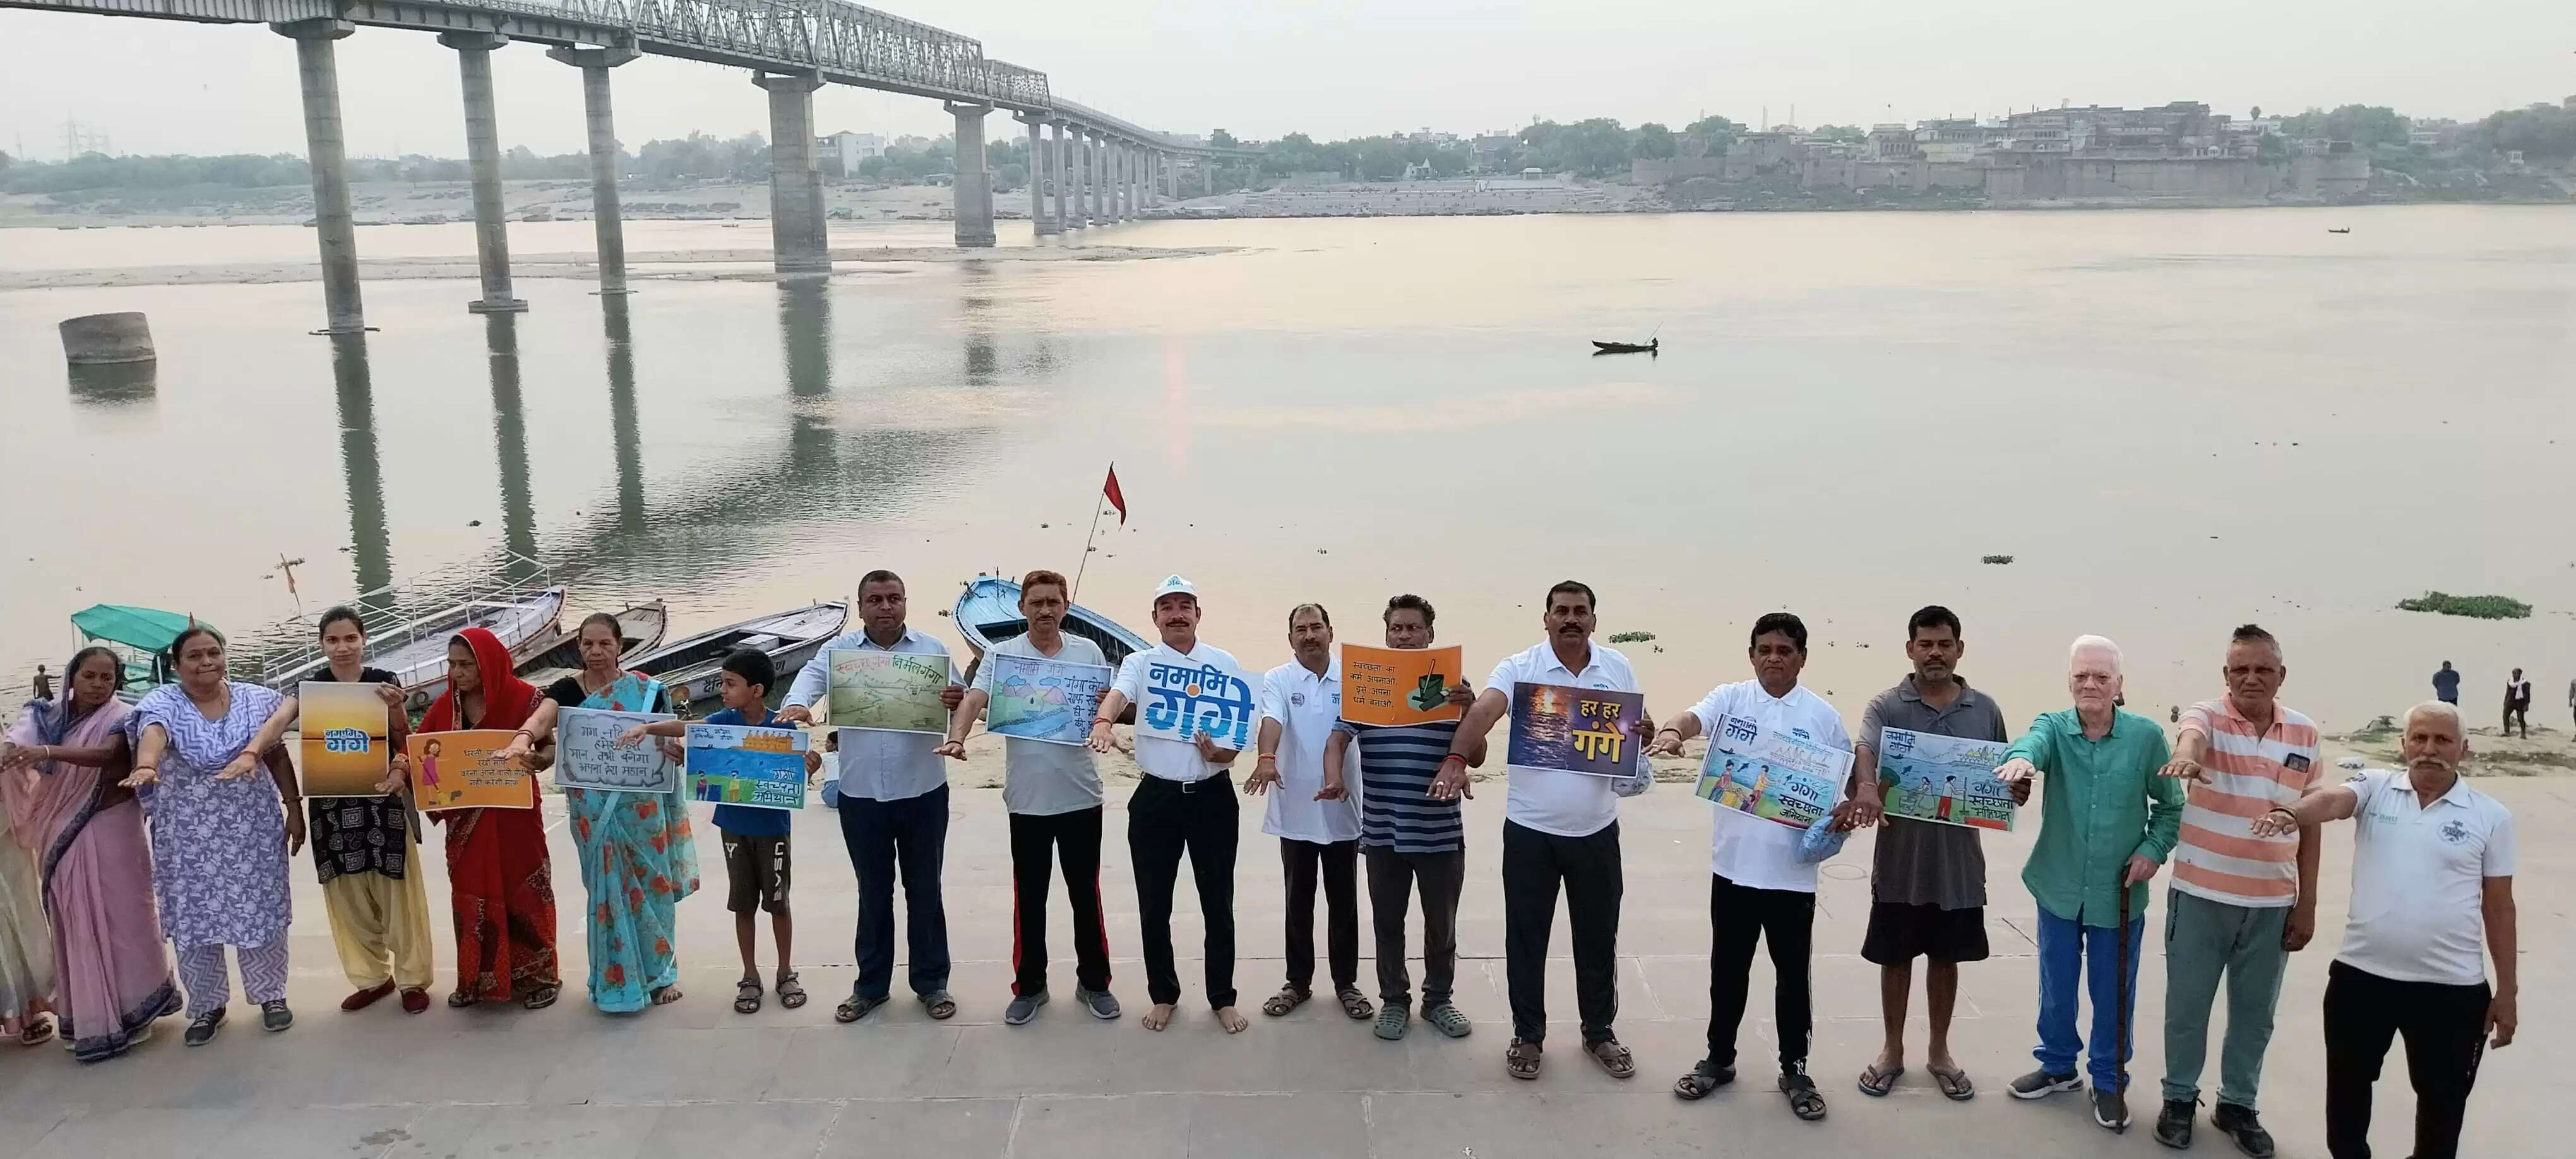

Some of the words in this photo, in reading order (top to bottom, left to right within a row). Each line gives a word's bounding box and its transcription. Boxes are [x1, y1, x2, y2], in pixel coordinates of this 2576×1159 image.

[892, 655, 922, 675] निर्मल
[920, 665, 943, 684] गंगा
[1354, 662, 1382, 672] स्वच्छता
[1064, 675, 1088, 692] गंगा
[1150, 662, 1229, 698] नमामि
[1350, 672, 1363, 682] कर्म
[1356, 686, 1367, 694] इसे
[1371, 687, 1392, 696] अपना
[1354, 696, 1366, 704] धर्म
[1145, 676, 1255, 751] गंगे
[1580, 700, 1599, 717] हर
[1602, 701, 1621, 719] हर
[325, 728, 357, 738] नमामि
[326, 730, 369, 753] गंगे
[1572, 721, 1626, 763] गंगे
[464, 748, 482, 758] धरती
[579, 763, 602, 774] अपना
[621, 766, 648, 777] महान
[1789, 777, 1821, 803] गंगा
[1778, 793, 1825, 816] स्वच्छता
[1968, 794, 2015, 810] स्वच्छता
